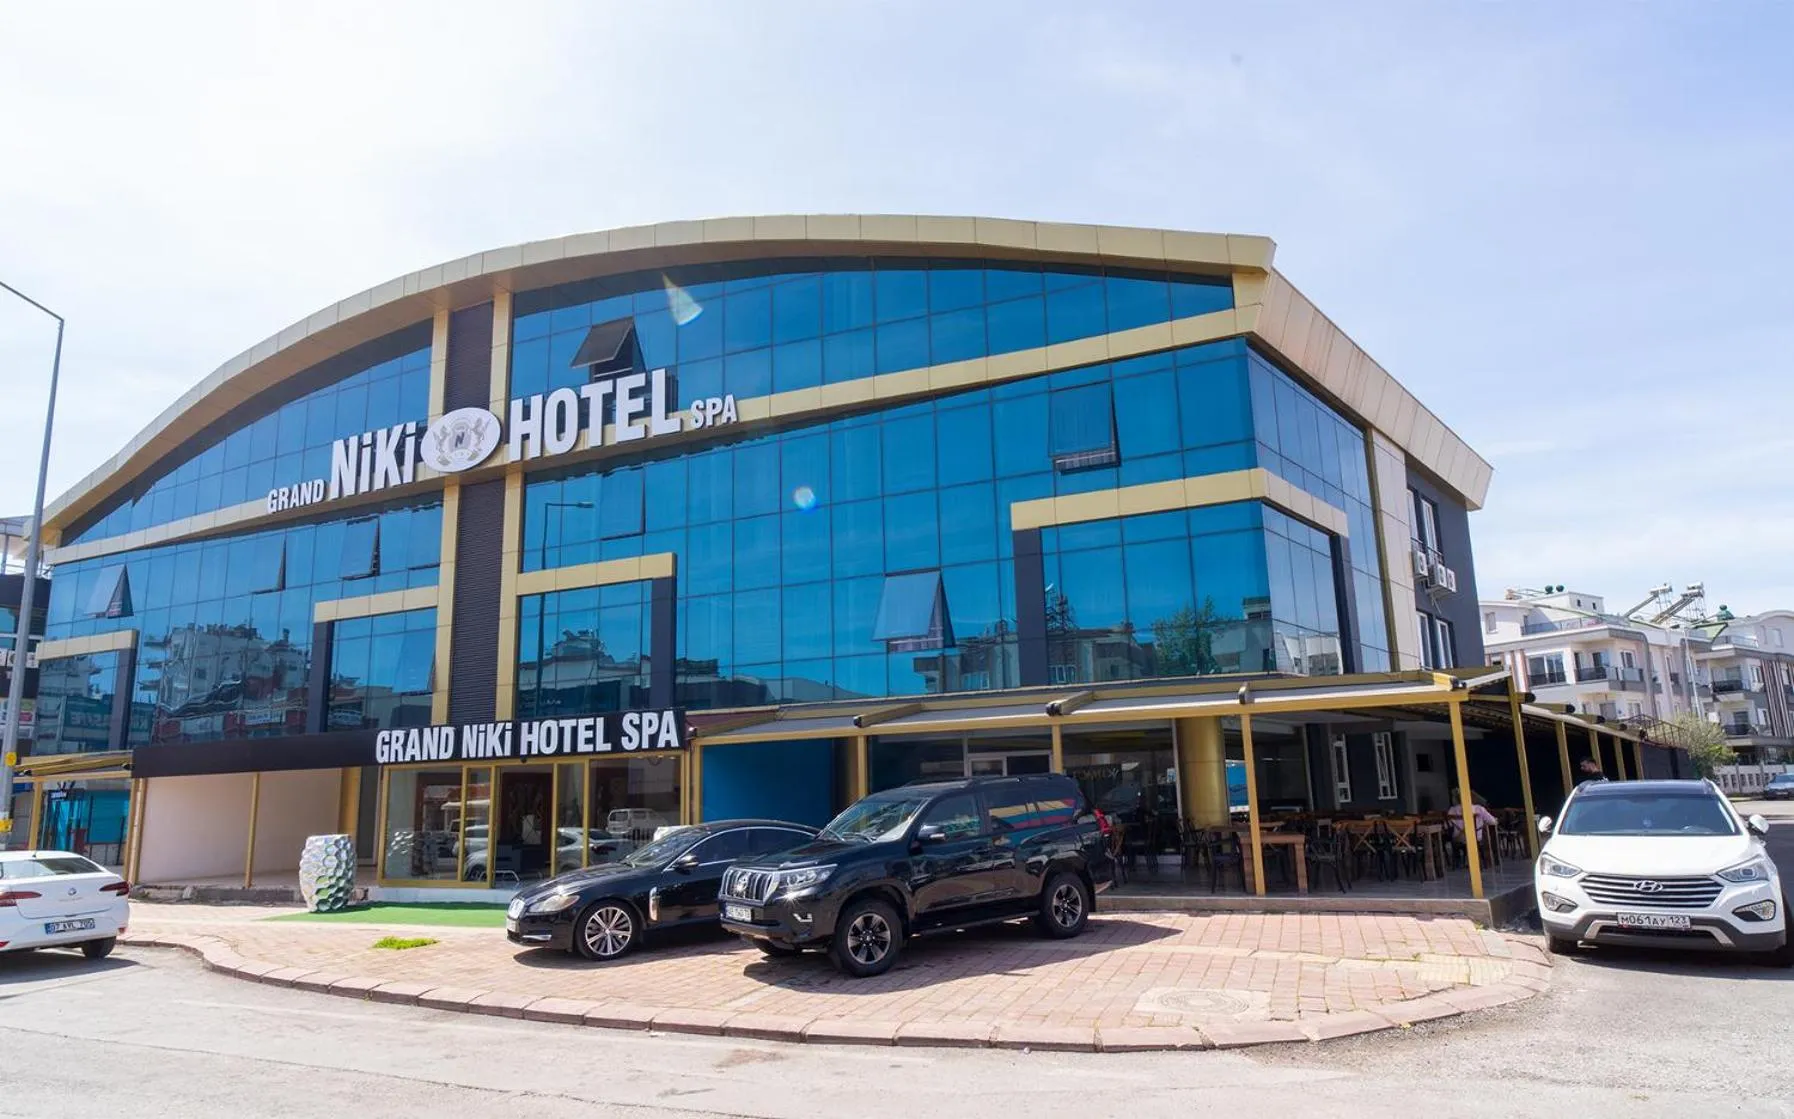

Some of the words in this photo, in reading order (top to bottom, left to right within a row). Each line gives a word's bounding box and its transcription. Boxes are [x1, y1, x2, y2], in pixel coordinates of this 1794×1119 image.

[267, 480, 327, 513] GRAND
[508, 369, 682, 463] HOTEL
[690, 393, 739, 430] SPA
[375, 726, 455, 763] GRAND
[519, 716, 611, 756] HOTEL
[620, 710, 679, 751] SPA
